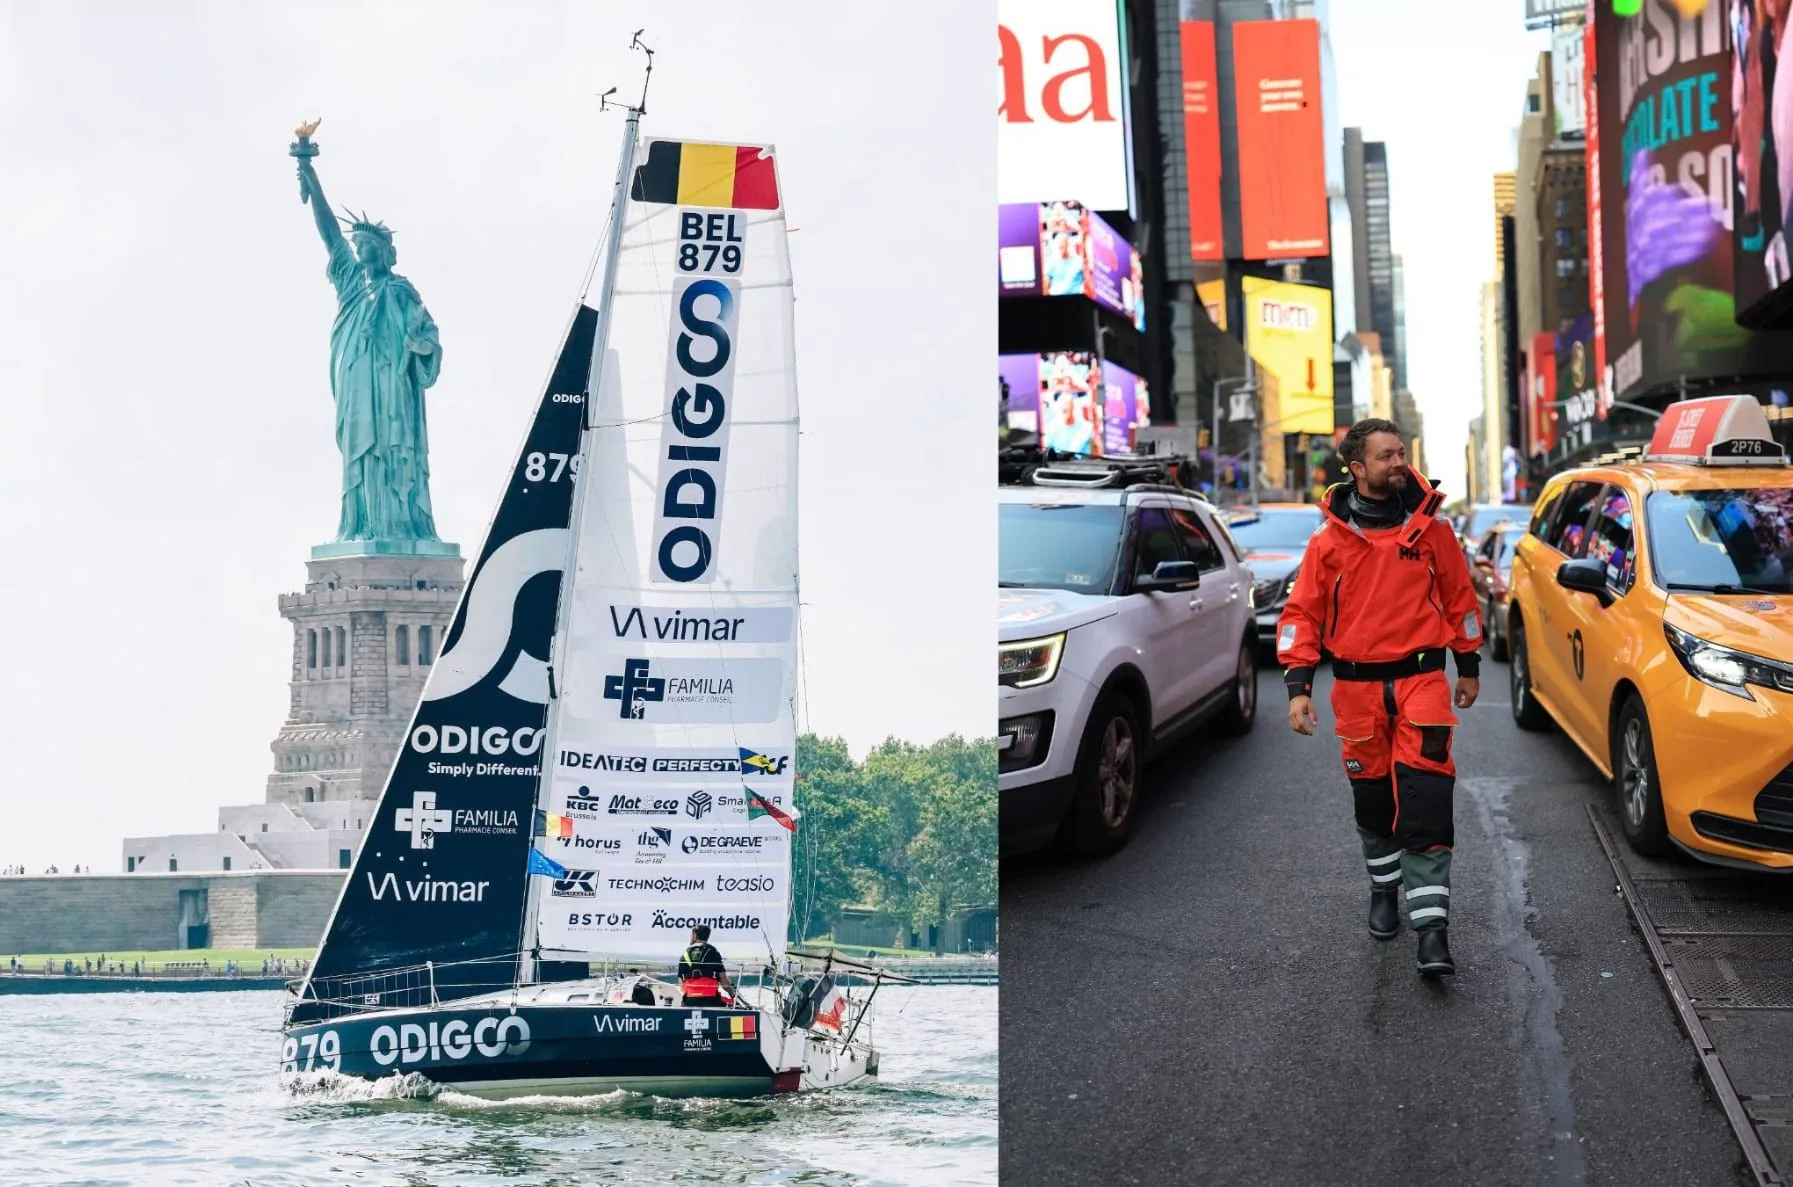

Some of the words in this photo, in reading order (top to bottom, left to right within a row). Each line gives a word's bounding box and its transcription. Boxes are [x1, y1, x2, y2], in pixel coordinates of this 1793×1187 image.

[681, 213, 742, 242] BEL
[679, 245, 741, 273] 879
[552, 394, 584, 404] ODIG
[1731, 441, 1762, 454] 2P76
[654, 610, 744, 640] vimar
[668, 678, 733, 694] FAMILIA
[560, 750, 647, 773] IDEATEC
[428, 762, 474, 778] Simply
[476, 763, 542, 777] Different.
[566, 800, 598, 811] KBC
[455, 810, 518, 826] FAMILIA
[575, 834, 622, 849] horus
[406, 874, 489, 902] vimar
[716, 875, 774, 892] teasio
[615, 1014, 663, 1032] vimar
[683, 1039, 712, 1048] FAMILIA
[281, 1030, 342, 1075] 879
